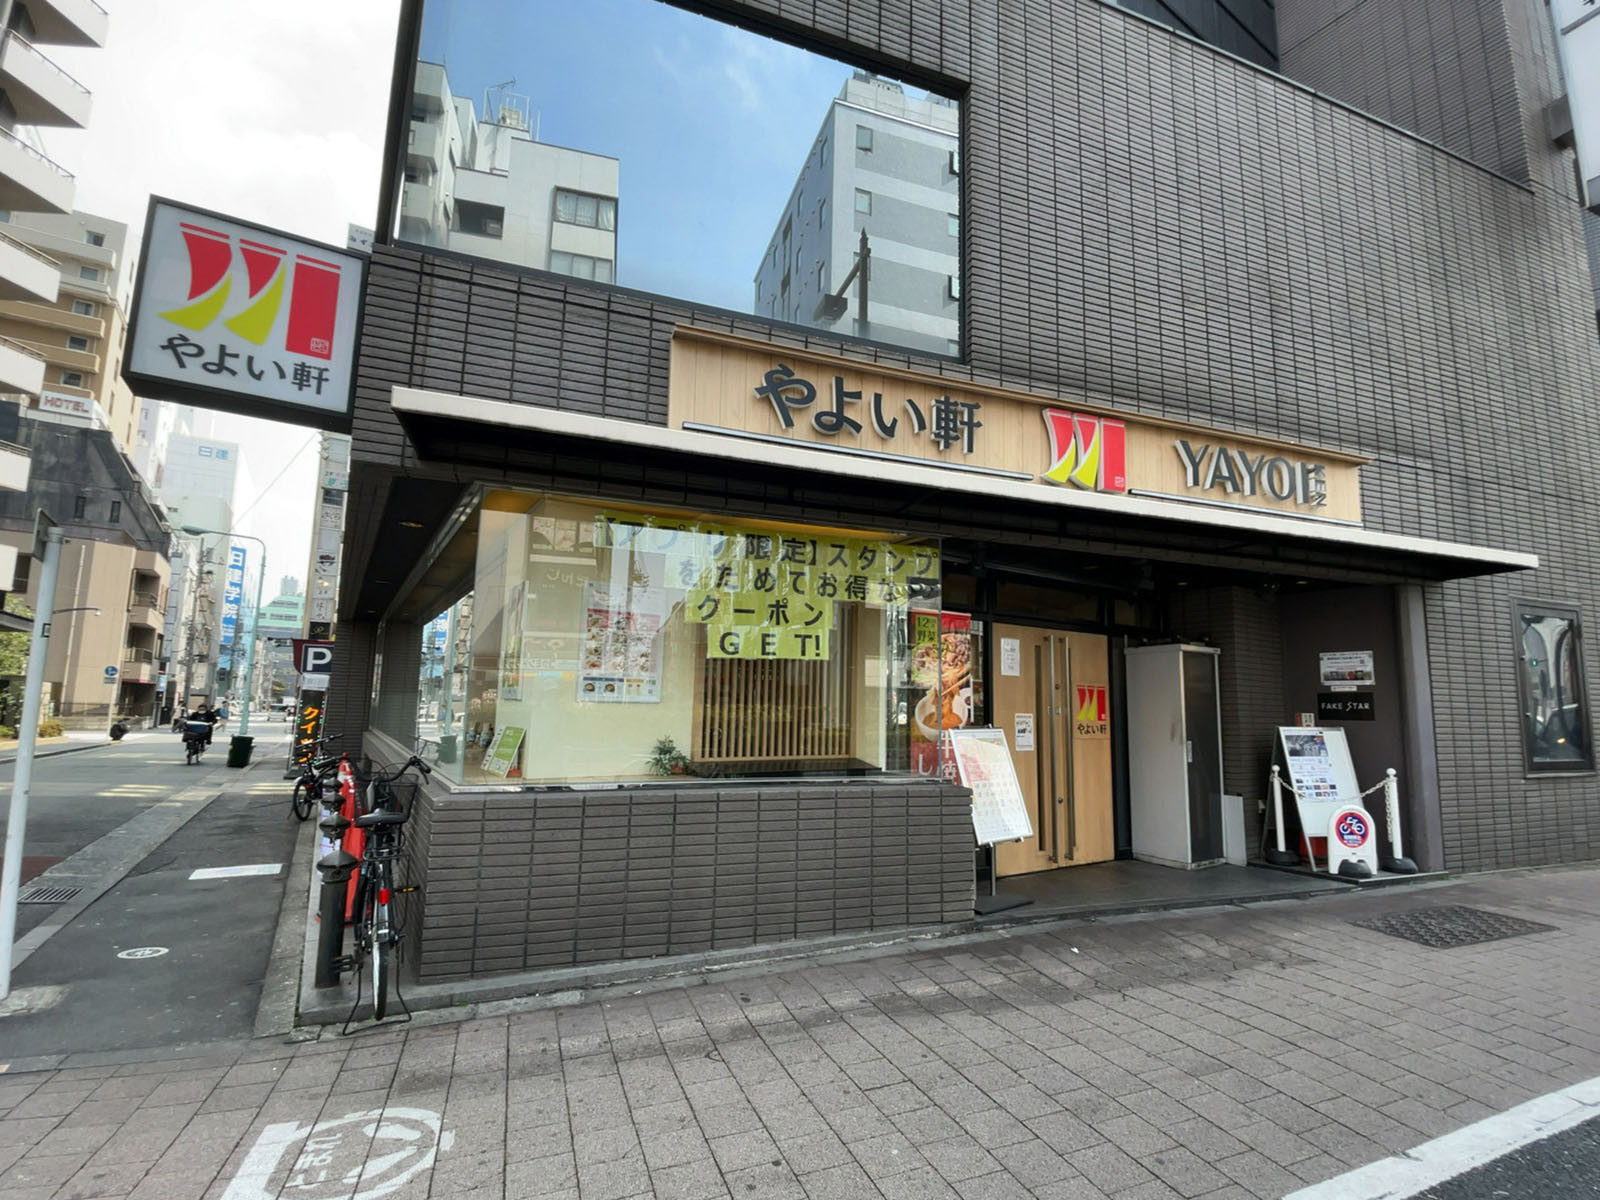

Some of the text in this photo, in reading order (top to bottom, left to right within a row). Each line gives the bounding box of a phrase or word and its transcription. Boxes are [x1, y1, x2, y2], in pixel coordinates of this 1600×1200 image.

[159, 333, 330, 395] やよい軒
[44, 395, 90, 414] HOTEL
[753, 363, 984, 454] やよい軒
[1174, 439, 1309, 505] YAYOI
[697, 595, 824, 627] クーポン
[305, 647, 332, 672] P
[1321, 702, 1343, 711] FAKE
